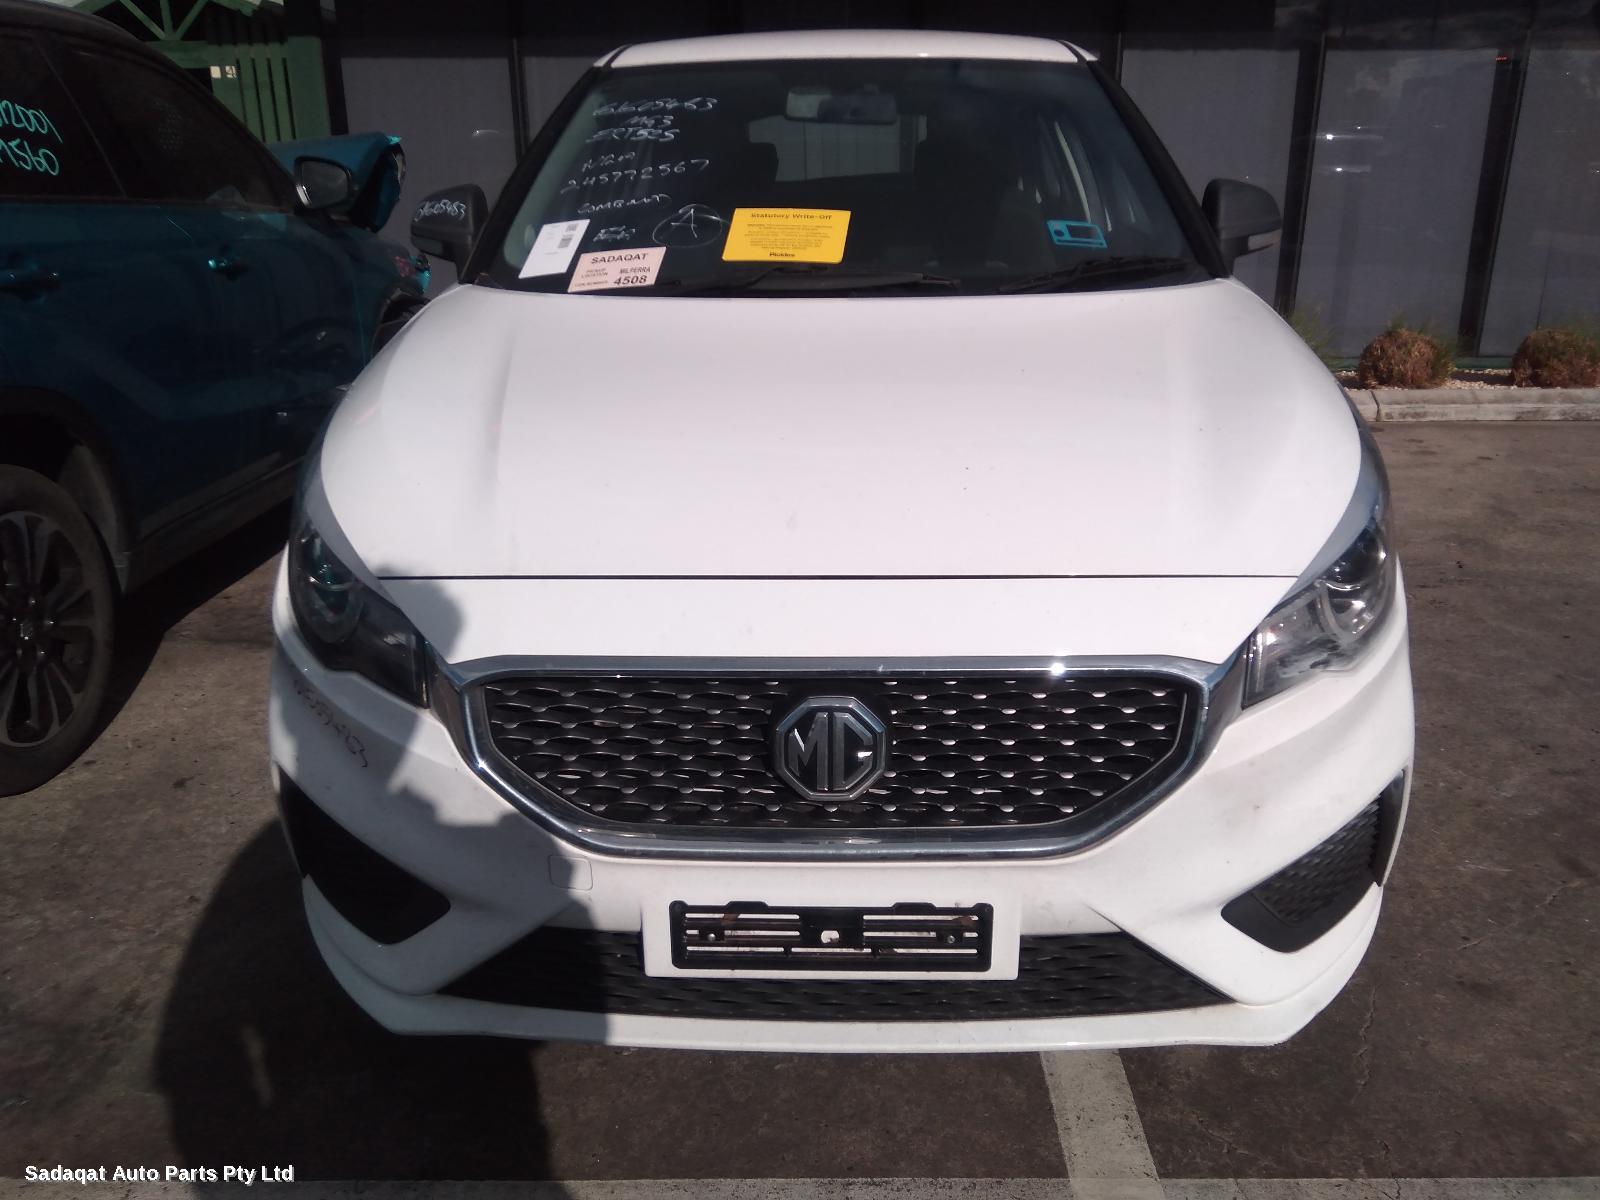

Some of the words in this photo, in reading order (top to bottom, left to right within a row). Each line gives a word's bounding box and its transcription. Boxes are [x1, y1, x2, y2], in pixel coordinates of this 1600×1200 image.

[591, 253, 650, 265] SADAQAT
[613, 275, 648, 286] 4508
[788, 711, 874, 791] MG
